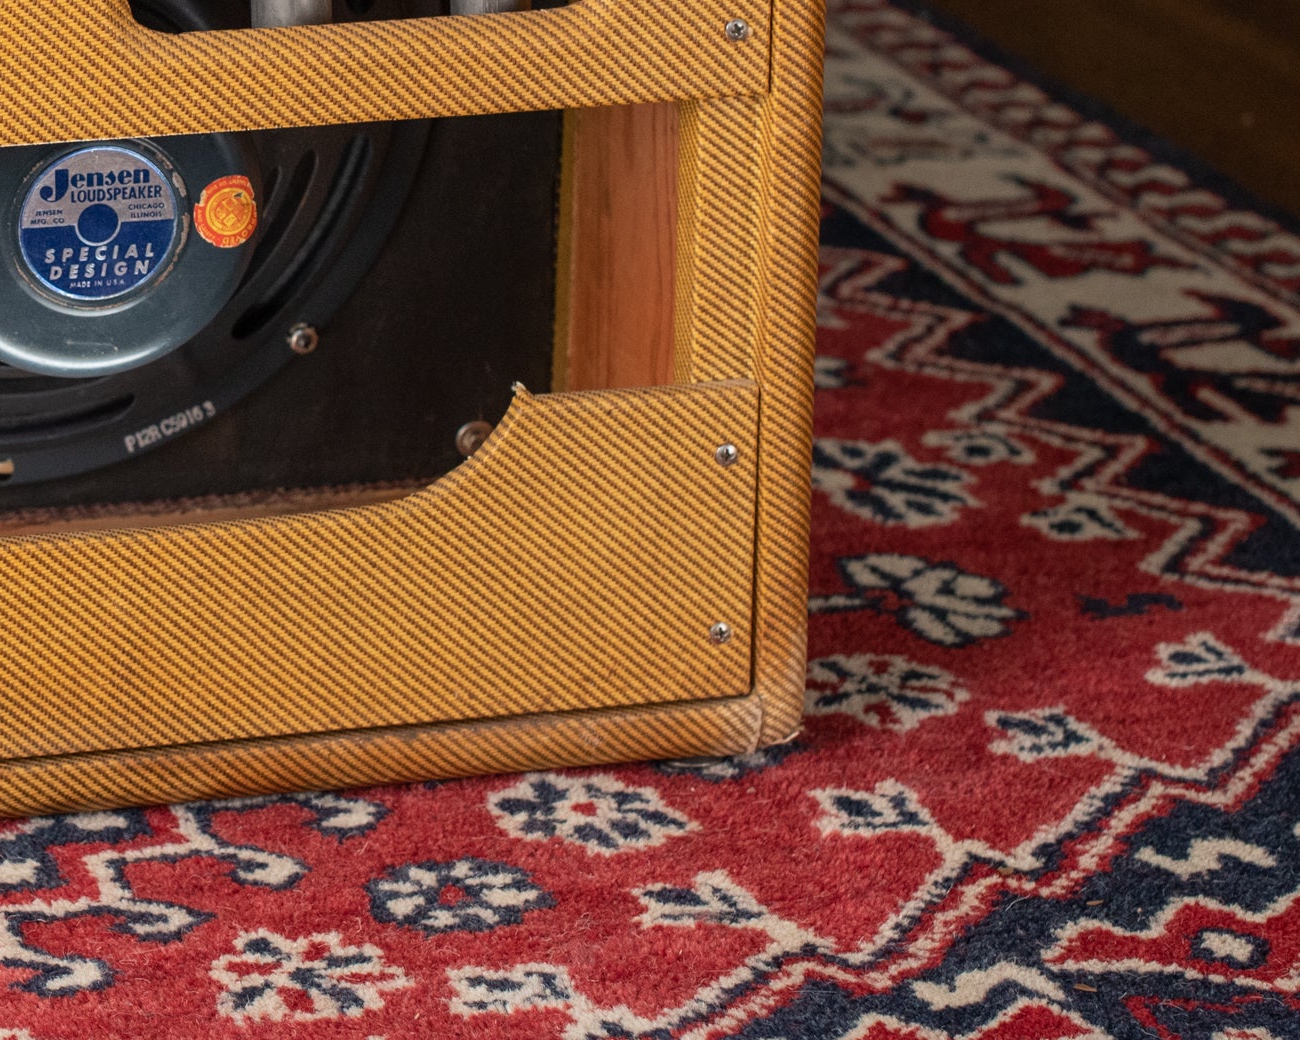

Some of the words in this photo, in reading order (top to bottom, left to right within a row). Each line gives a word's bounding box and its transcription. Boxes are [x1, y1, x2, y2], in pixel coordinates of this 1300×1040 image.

[39, 167, 151, 203] Jensen
[70, 185, 163, 203] LOUDSPEAKER
[35, 209, 64, 217] JENSEN
[127, 202, 165, 211] CHICAGO
[130, 211, 163, 219] ILLINOIS
[43, 242, 155, 264] SPECIAL
[48, 259, 150, 281] DESIGN
[69, 280, 91, 289] MADE
[94, 279, 104, 287] IN
